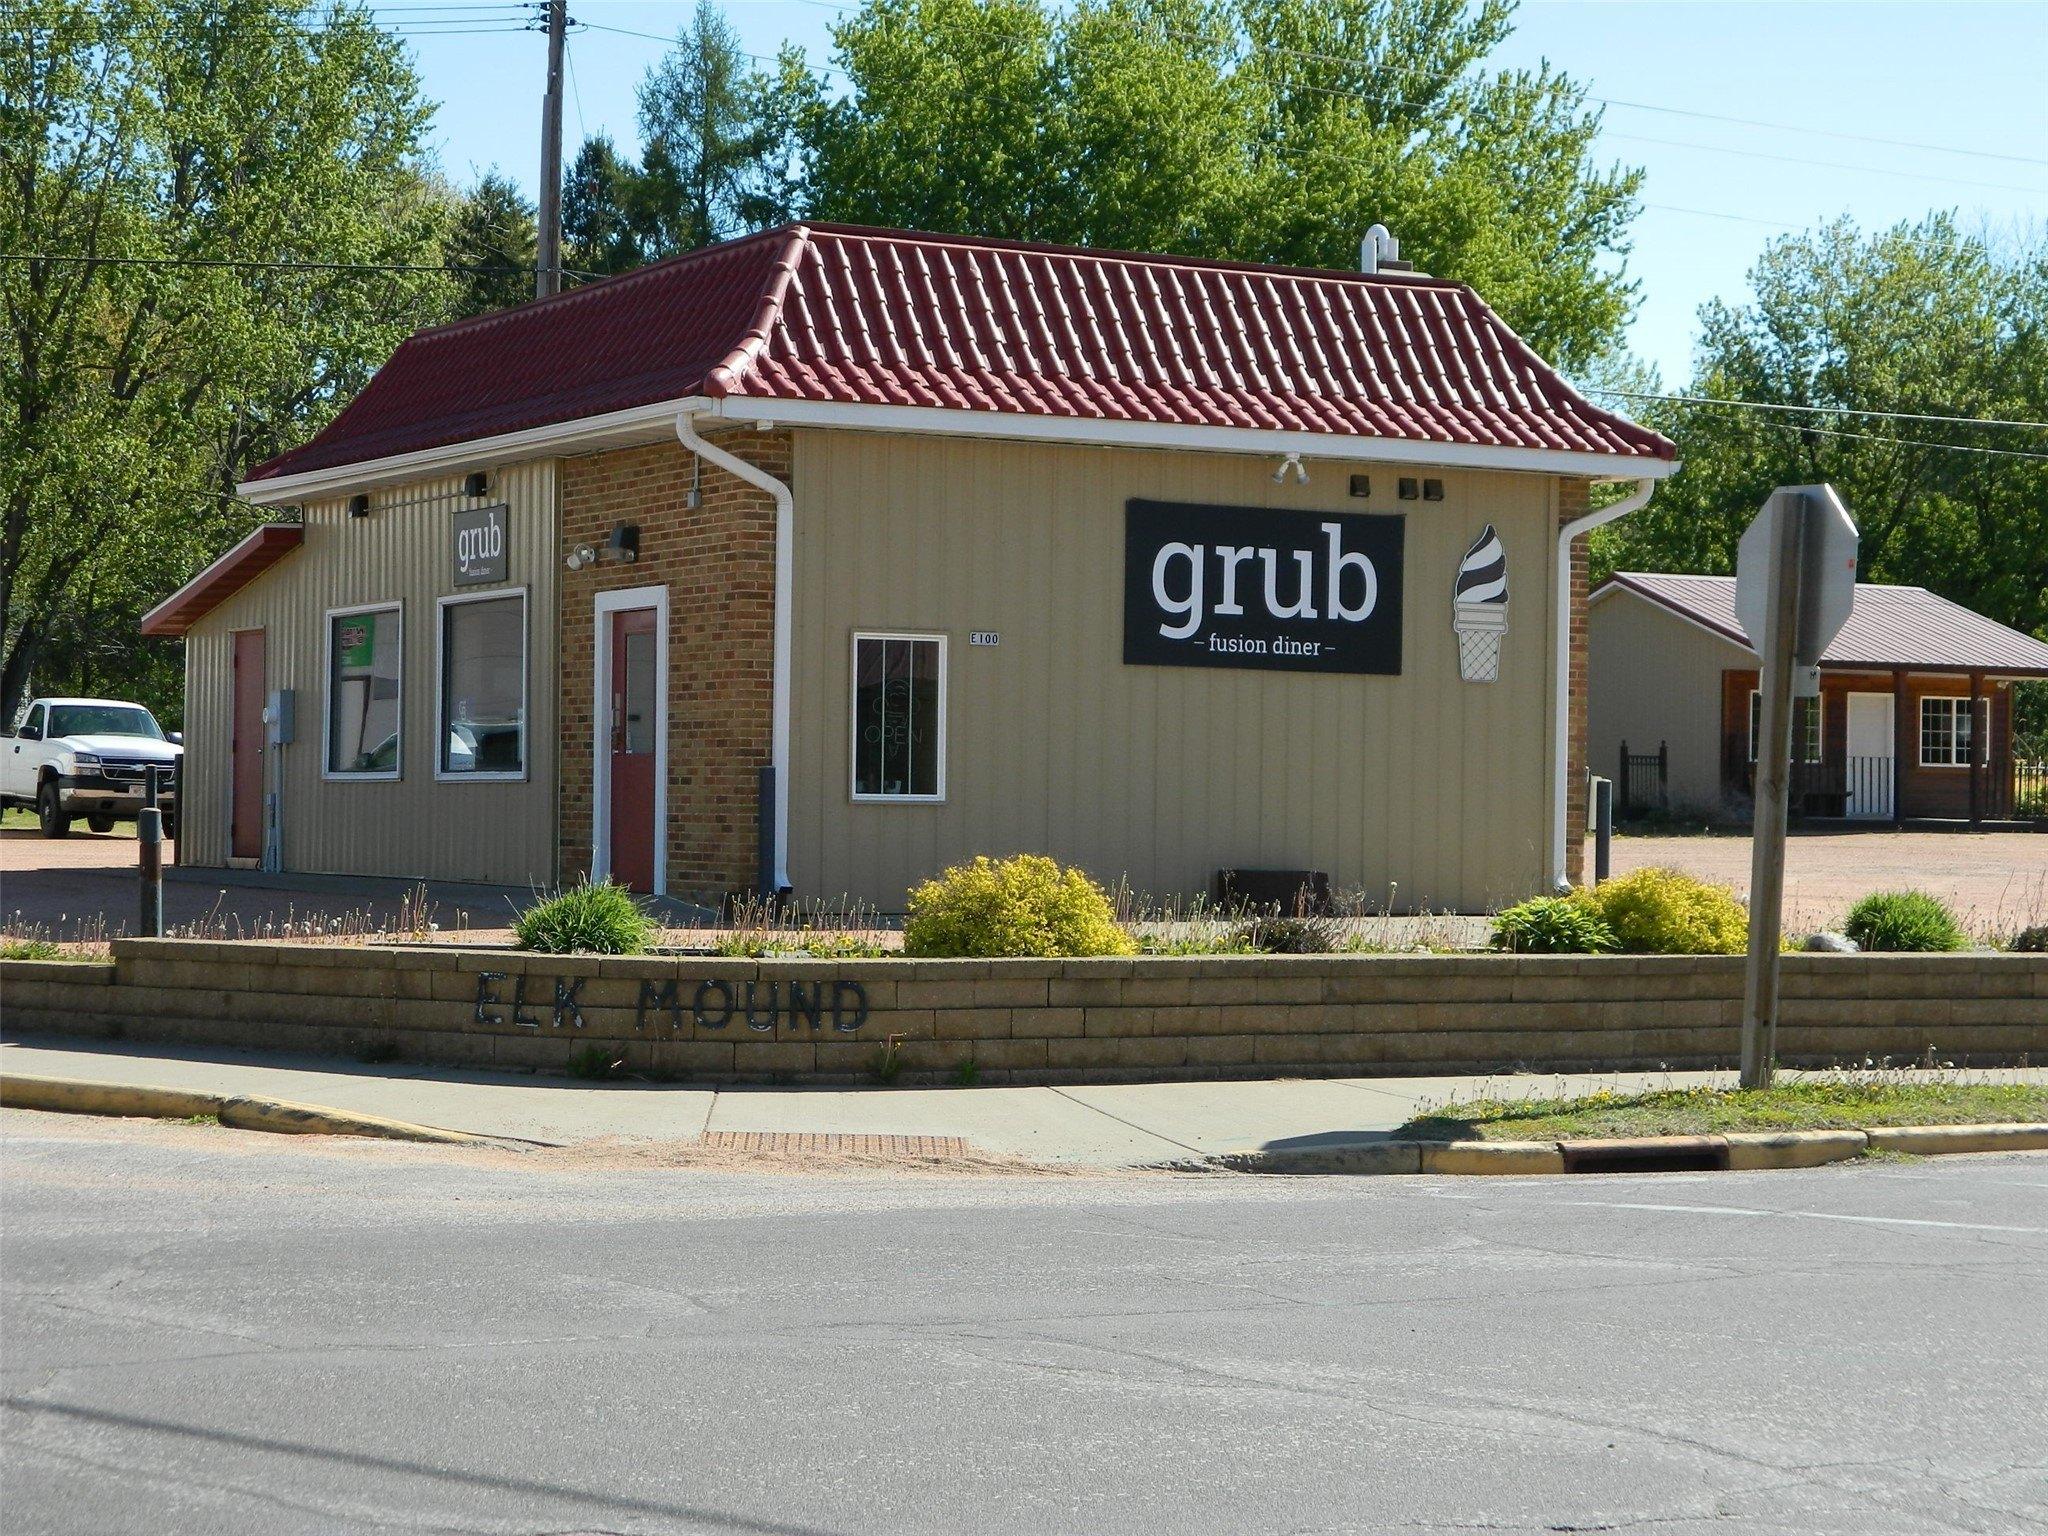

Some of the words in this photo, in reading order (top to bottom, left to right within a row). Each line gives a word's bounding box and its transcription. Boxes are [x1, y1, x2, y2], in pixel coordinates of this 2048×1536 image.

[458, 512, 501, 573] grub
[1152, 522, 1378, 640] grub
[970, 632, 999, 645] E100
[1208, 632, 1268, 654] fusion
[1272, 635, 1321, 656] diner
[474, 971, 587, 1029] ELK
[632, 979, 869, 1032] MOUND
